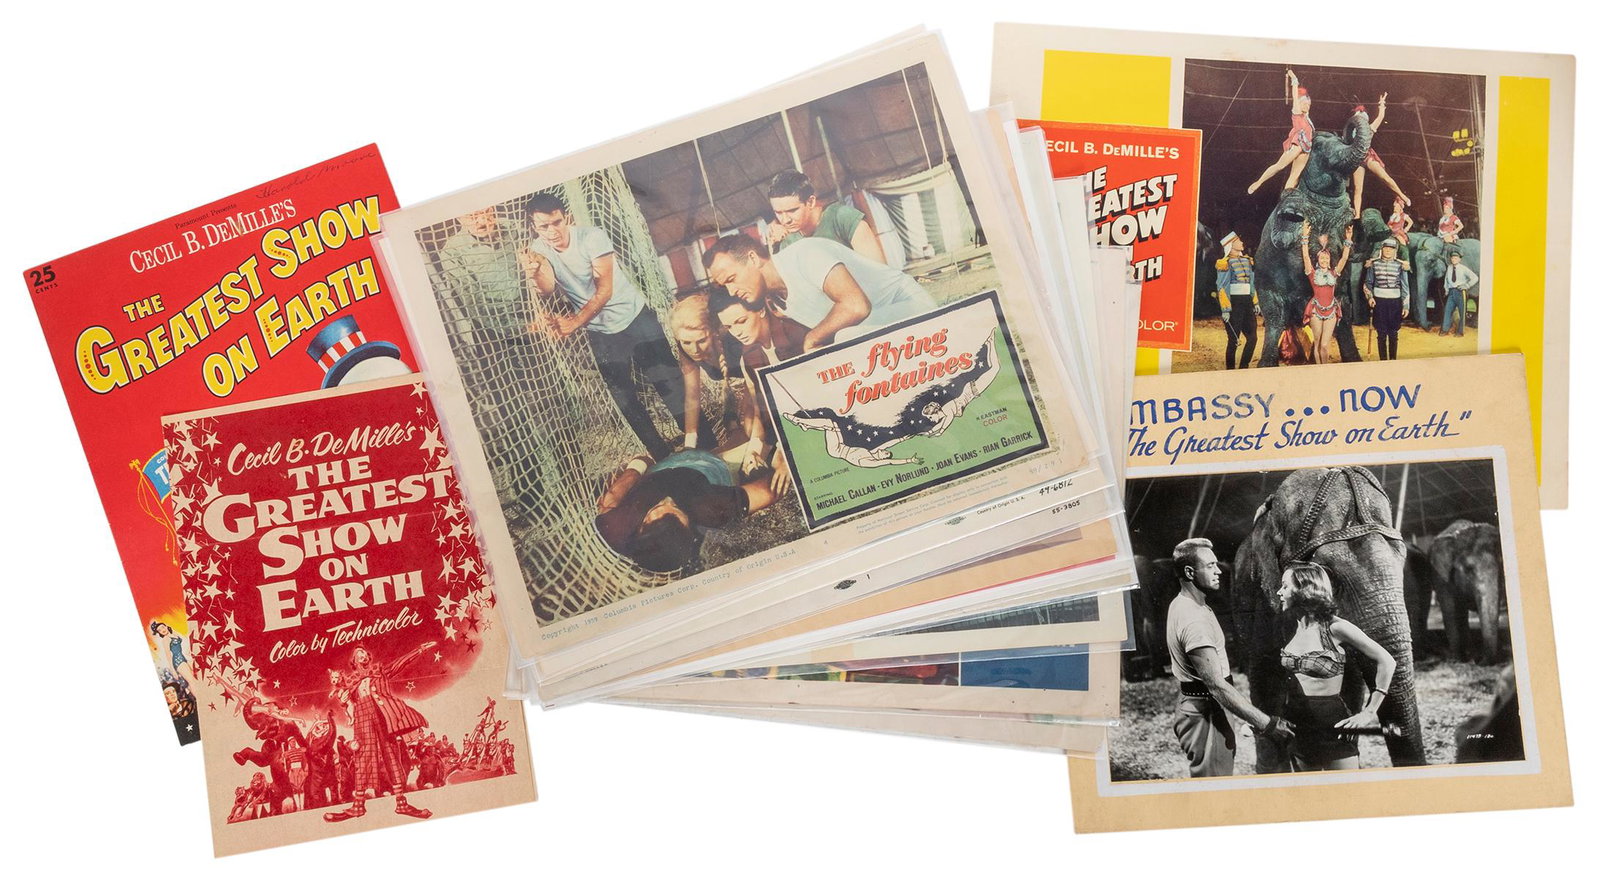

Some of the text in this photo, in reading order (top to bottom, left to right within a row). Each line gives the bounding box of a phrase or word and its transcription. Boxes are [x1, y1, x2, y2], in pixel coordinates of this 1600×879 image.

[1045, 140, 1180, 160] ECIL B. DEMILLE'S
[174, 203, 237, 230] Paramount Presents
[1087, 173, 1178, 223] EATEST
[129, 198, 297, 274] CECIL B. DEMILLE'S
[1089, 204, 1169, 248] HOW
[29, 265, 57, 287] 25
[35, 282, 58, 294] CENTS
[75, 195, 382, 395] GREATEST SHOW
[122, 293, 165, 323] THE
[202, 257, 382, 398] ON EARTH
[816, 328, 949, 385] THE flying
[838, 352, 974, 415] fontaines
[1130, 393, 1275, 425] MBASSY
[983, 413, 1009, 427] COLOR
[1163, 421, 1270, 465] Greatest
[1273, 418, 1338, 450] Show
[1345, 427, 1376, 445] on
[227, 441, 283, 476] Cecil
[310, 421, 417, 458] DeMille's
[287, 455, 373, 491] THE
[815, 431, 1033, 511] MICHAEL CALLAN EVY NORLUND JOAN EVANS RIAN GARRICK
[202, 469, 453, 544] GREATEST
[257, 513, 409, 580] SHOW
[318, 553, 369, 581] ON
[256, 570, 426, 633] EARTH
[541, 623, 580, 641] Copyright
[603, 604, 637, 620] Columbia
[640, 592, 674, 607] Pictures
[677, 583, 699, 595] Corp.
[702, 571, 731, 586] Country
[735, 565, 744, 575] of
[746, 557, 773, 570] Origin
[269, 606, 424, 664] Color by Technicolor
